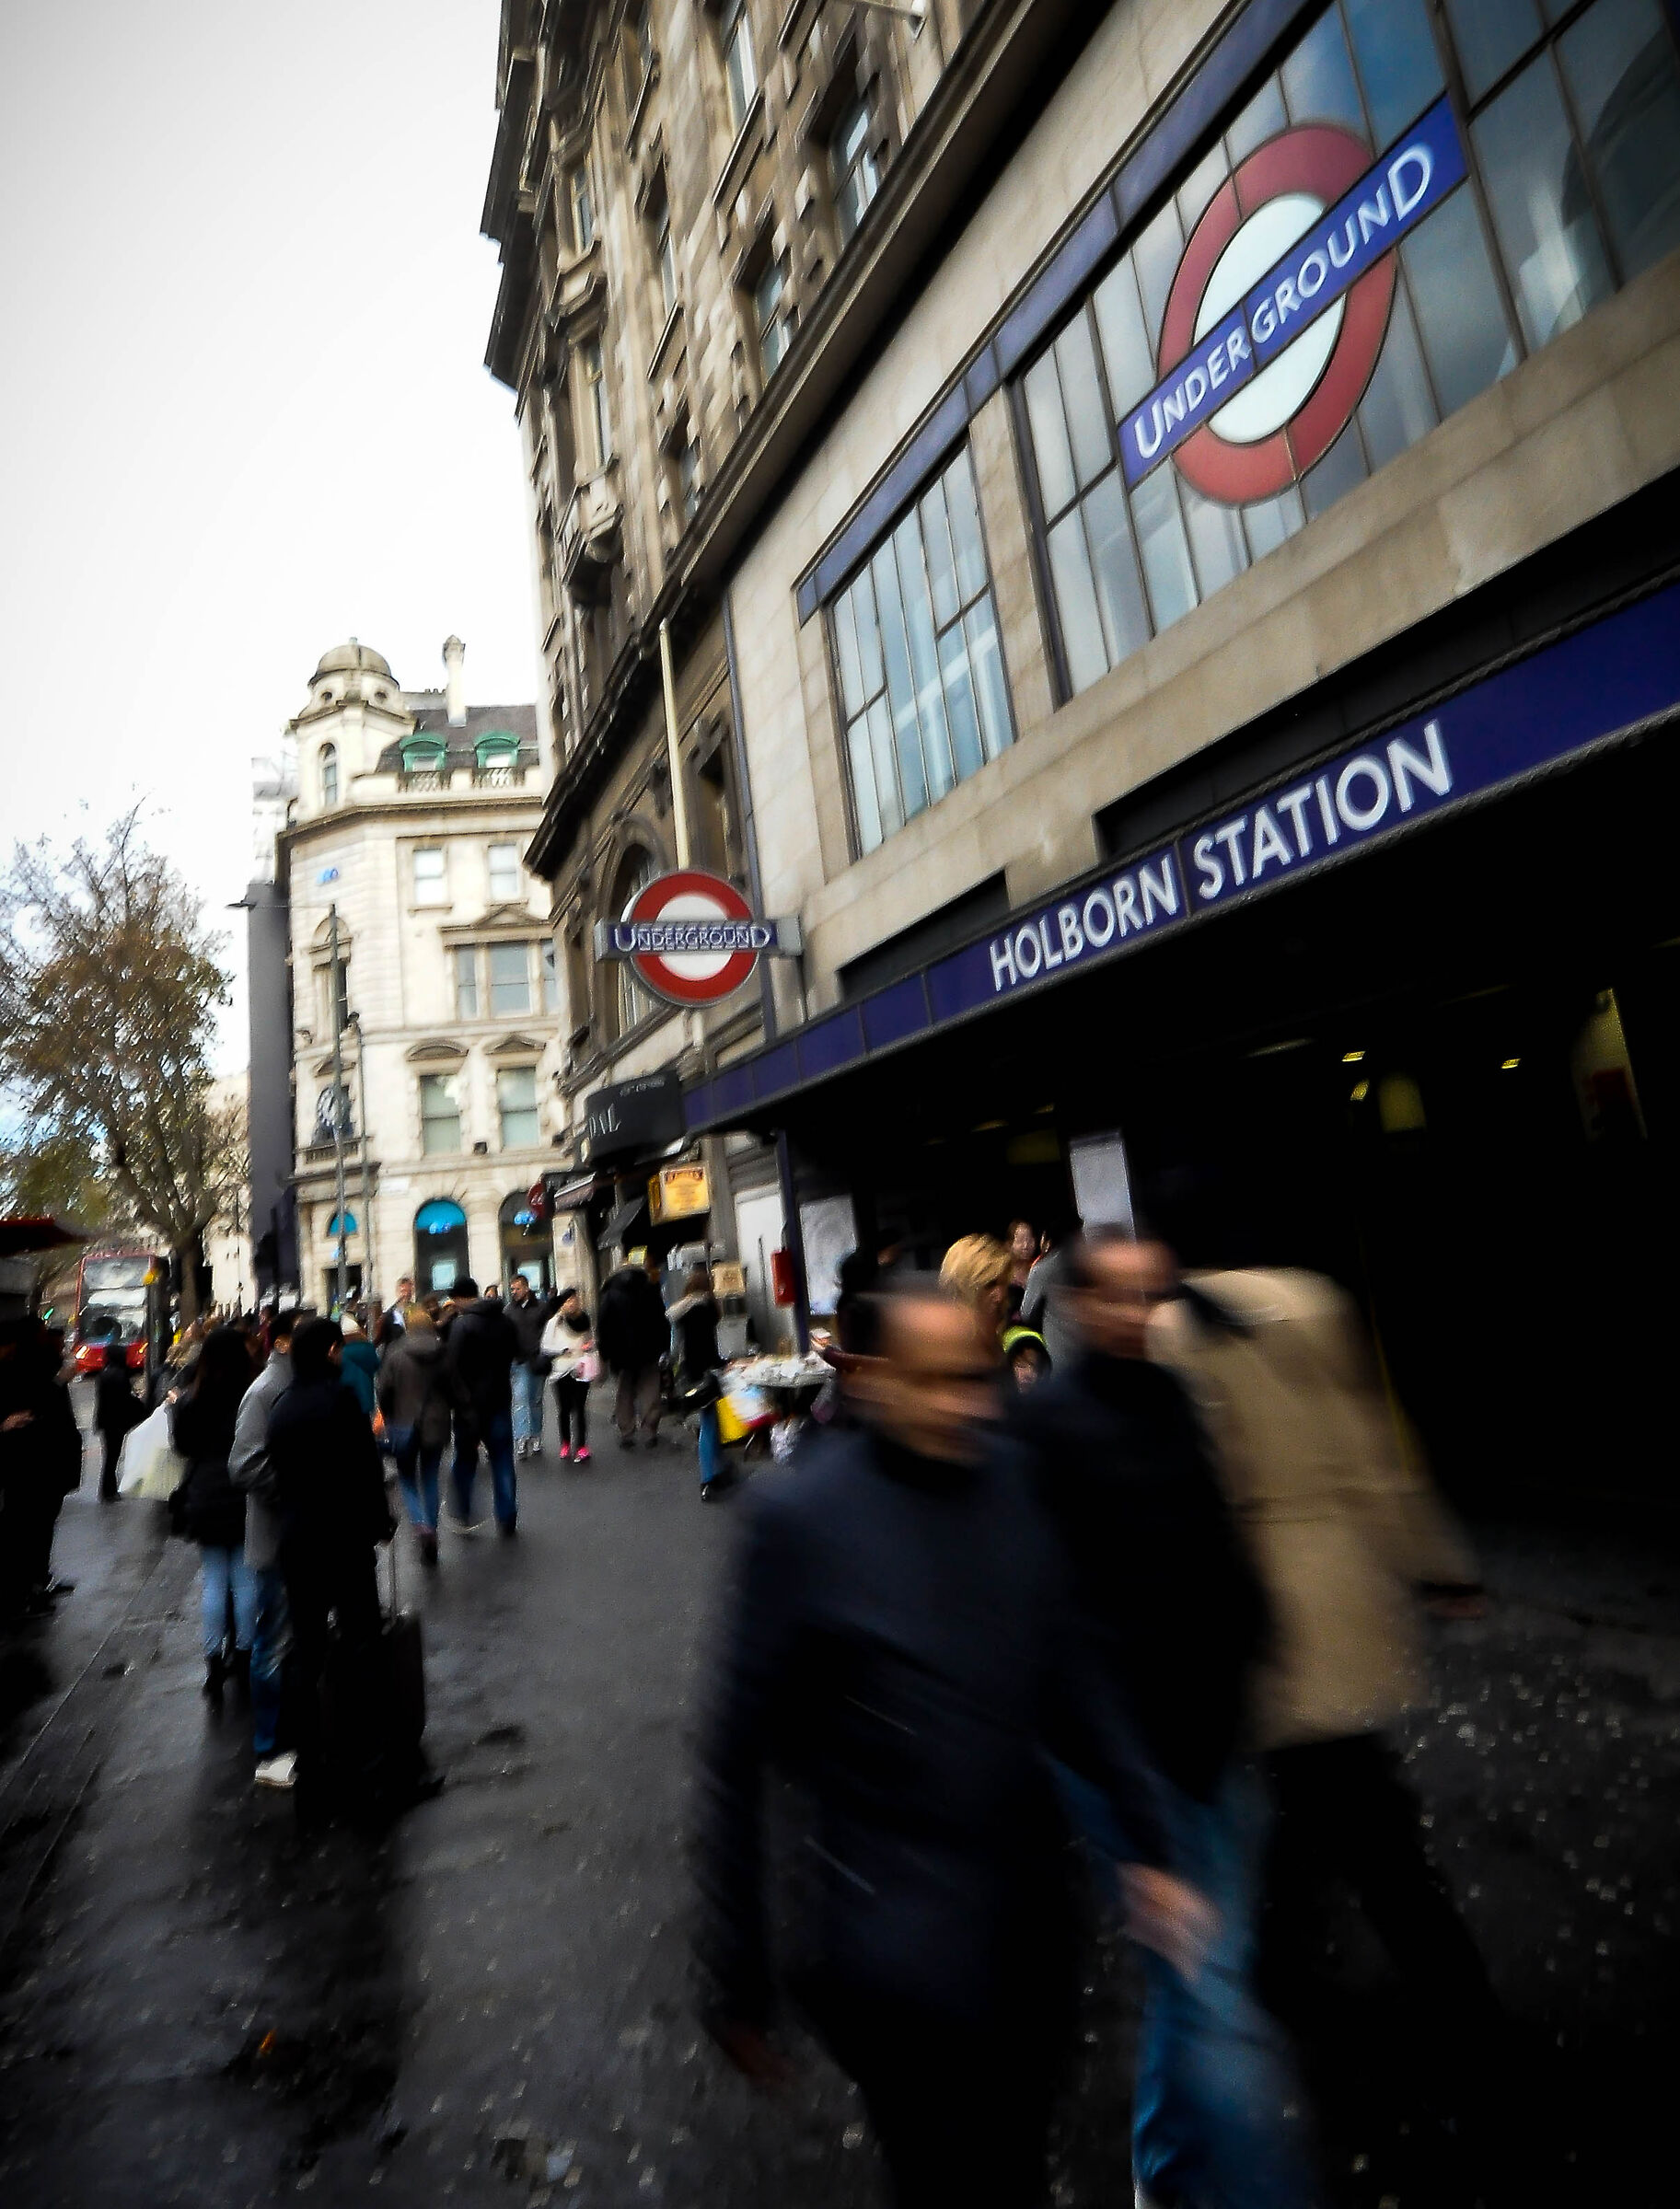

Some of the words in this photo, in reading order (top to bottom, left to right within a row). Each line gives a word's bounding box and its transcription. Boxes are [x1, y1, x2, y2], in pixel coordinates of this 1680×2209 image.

[1134, 144, 1433, 458] UNDERGROUND
[614, 924, 770, 953] UNDERGROUND
[991, 856, 1180, 991] HOLBORN
[1194, 721, 1453, 900] STATION
